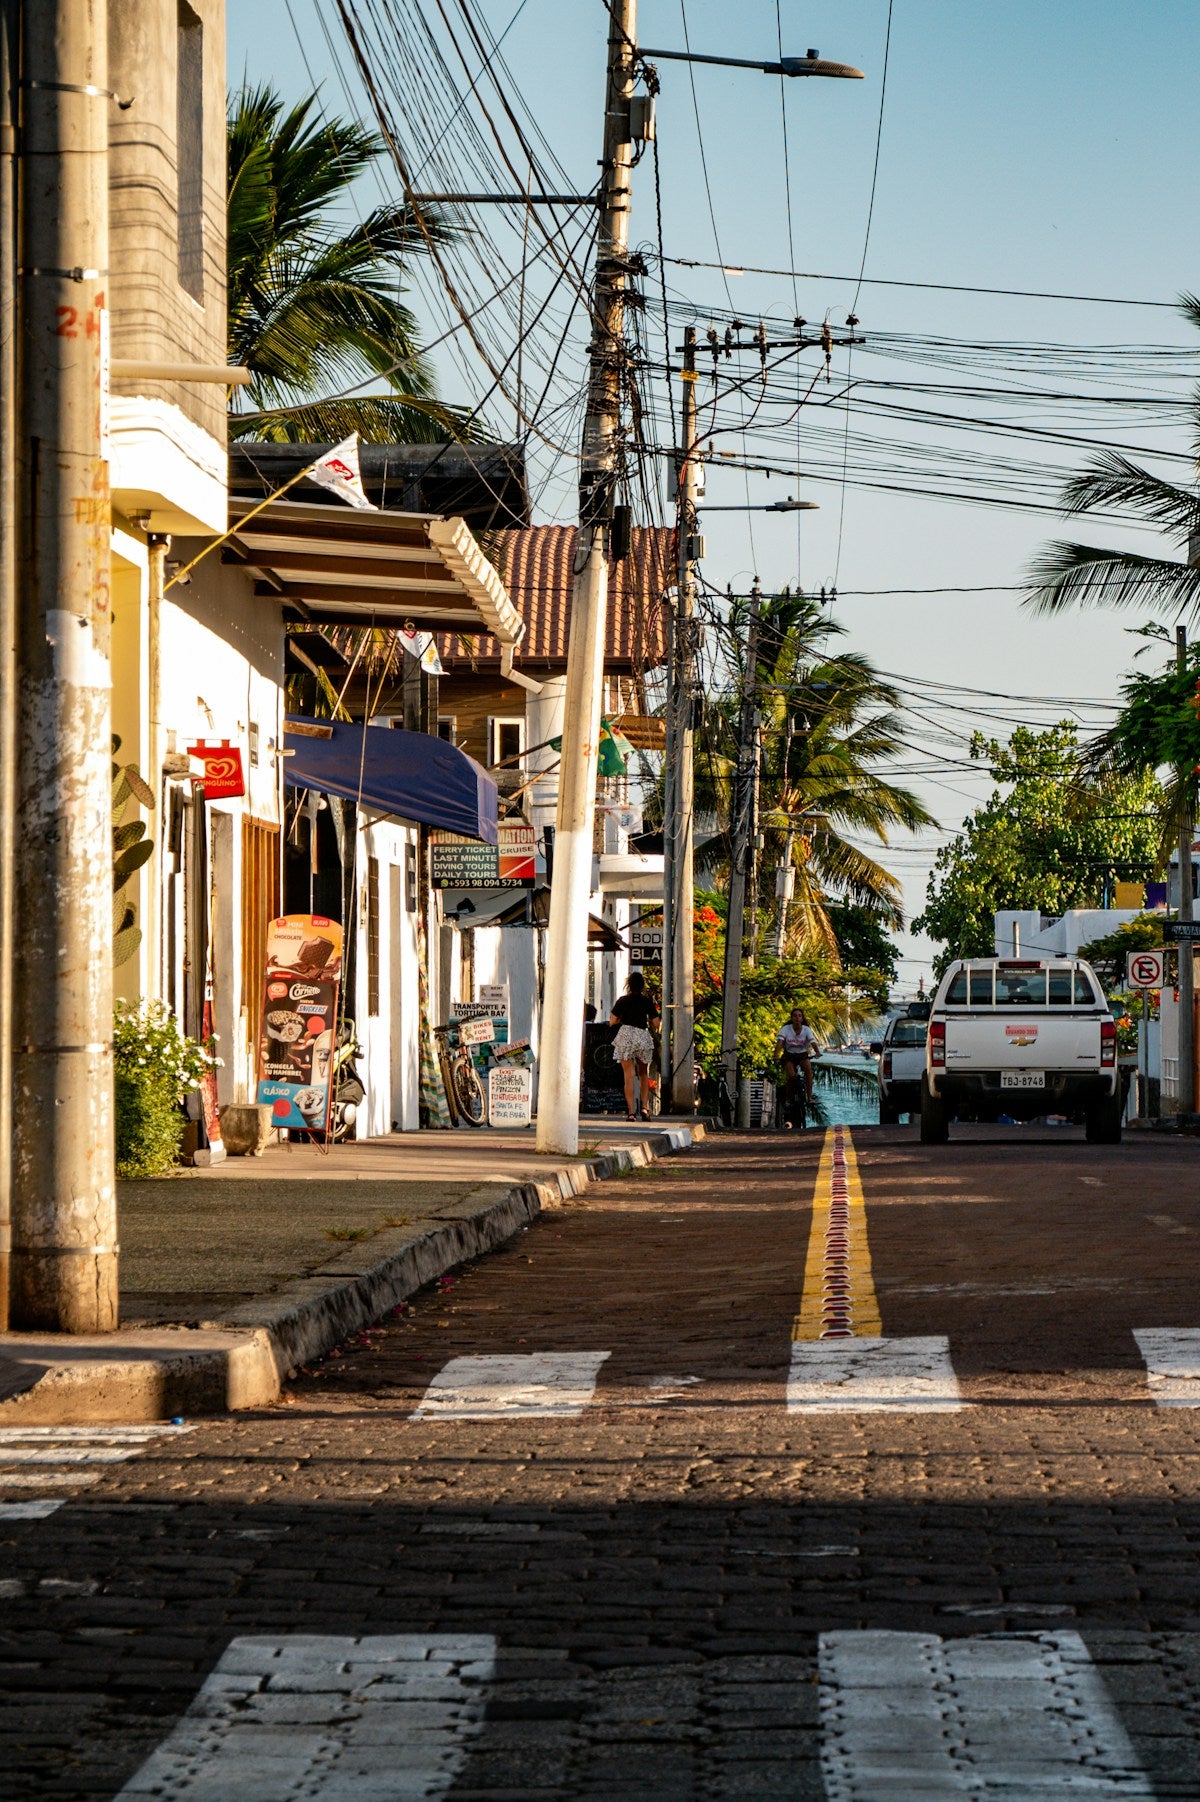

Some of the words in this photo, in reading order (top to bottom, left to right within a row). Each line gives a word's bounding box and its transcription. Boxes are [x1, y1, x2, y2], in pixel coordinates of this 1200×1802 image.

[433, 846, 463, 854] FERRY
[465, 846, 497, 854] TICKET
[500, 846, 534, 854] CRUISE
[433, 854, 459, 862] LAST
[460, 854, 497, 862] MINUTE
[466, 862, 496, 870] TOURS
[449, 879, 470, 887] +593
[471, 879, 483, 887] 98
[483, 879, 500, 887] 094
[501, 879, 522, 887] 5734
[1138, 961, 1153, 979] E
[289, 983, 321, 1001] Cornetto
[298, 1005, 326, 1013] SNICKERS
[473, 1021, 492, 1030] BIKES
[475, 1034, 492, 1042] RENT
[1002, 1077, 1044, 1087] TBJ-8748
[263, 1086, 290, 1095] CLÁSICO
